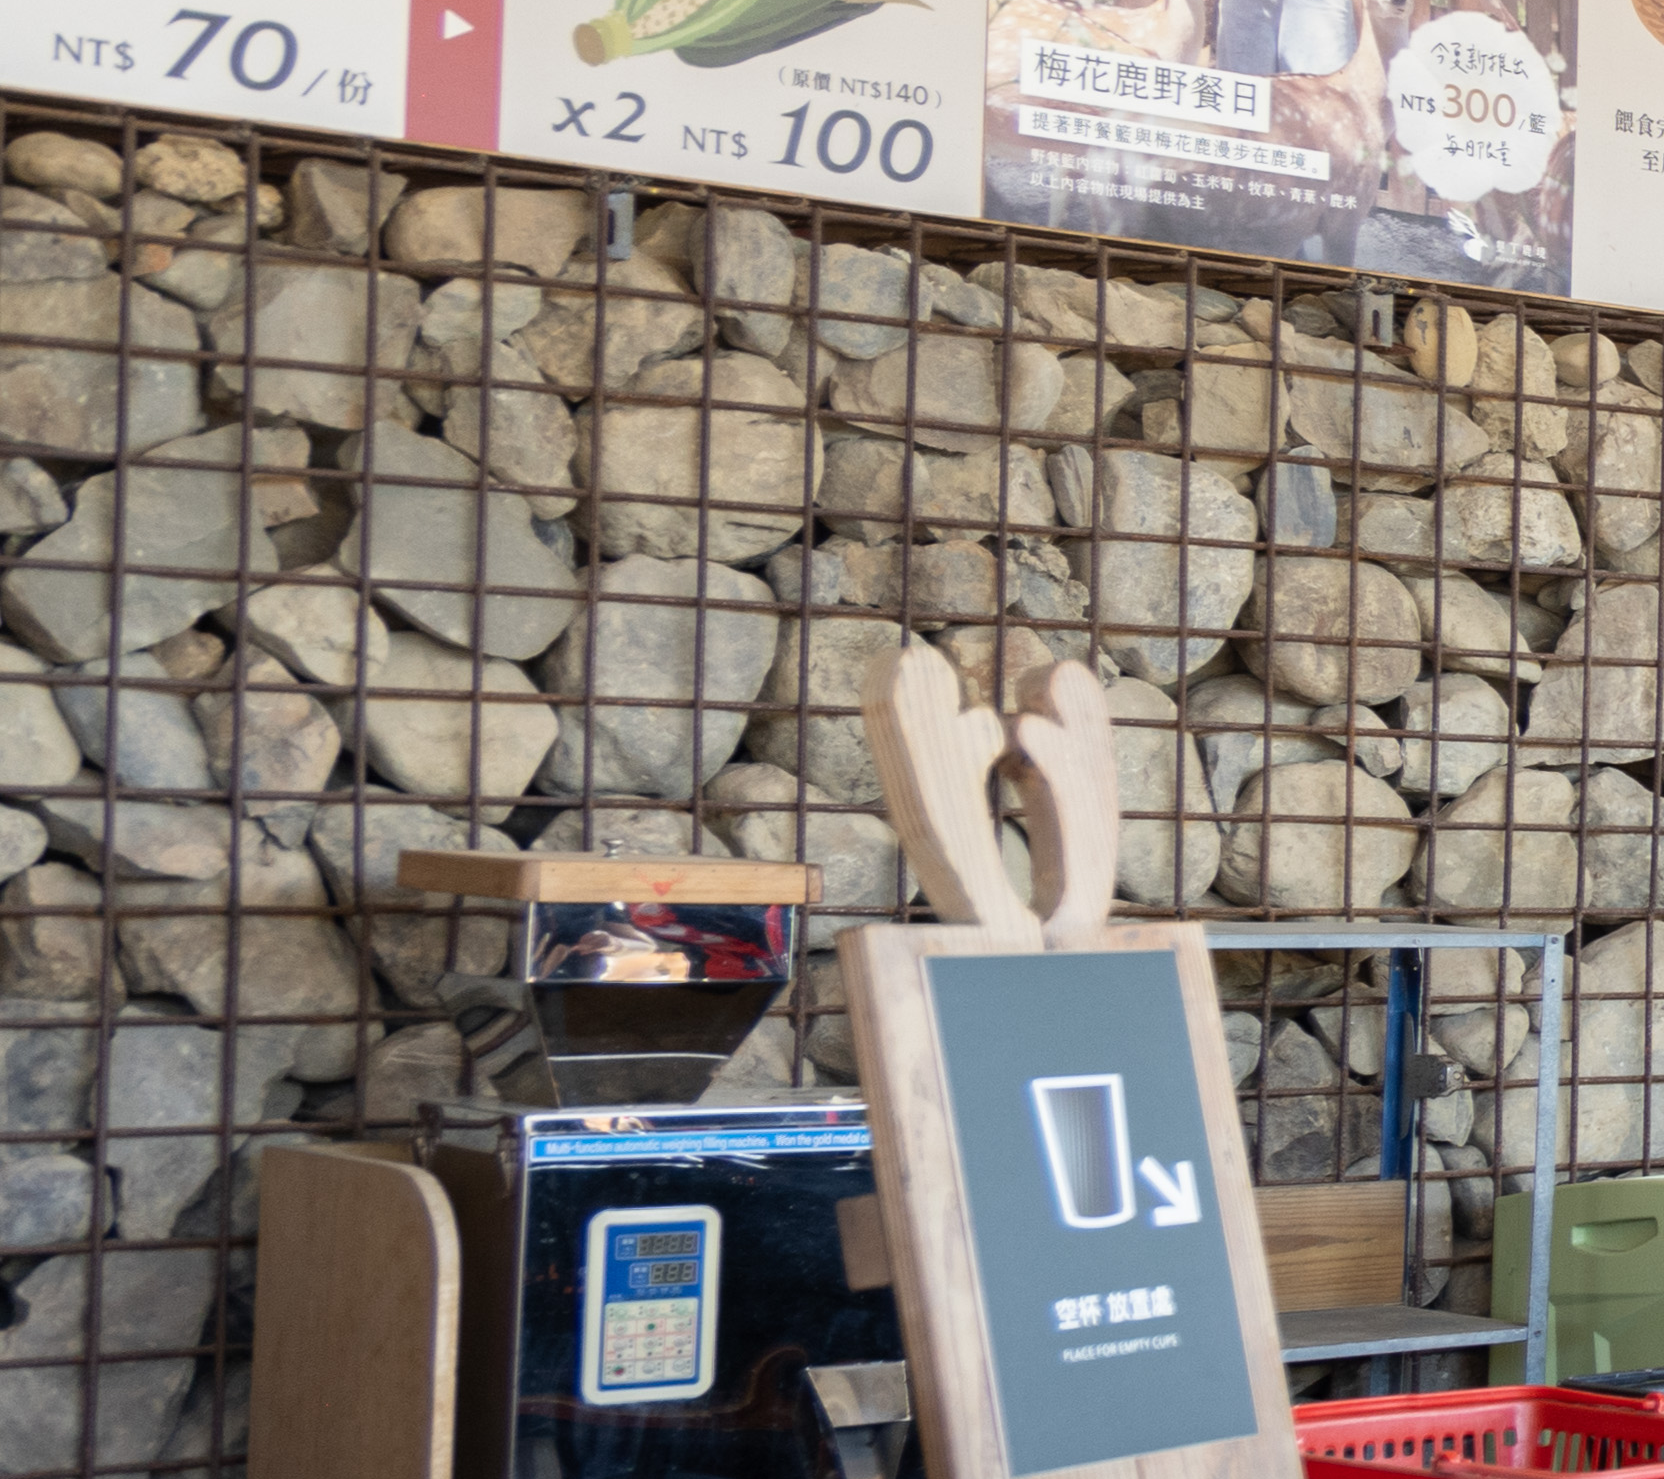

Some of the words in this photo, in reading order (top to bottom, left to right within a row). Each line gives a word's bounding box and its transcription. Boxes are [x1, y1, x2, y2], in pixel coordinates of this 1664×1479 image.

[51, 32, 136, 73] NT$
[1033, 45, 1258, 118] 梅花鹿野餐日
[1400, 93, 1436, 115] NT$
[680, 124, 750, 161] NT$
[768, 98, 935, 185] 100
[1442, 132, 1513, 168] 每日限量
[776, 1132, 796, 1147] Won
[796, 1131, 812, 1146] the
[812, 1129, 833, 1149] gold
[833, 1127, 860, 1145] medal
[1055, 1294, 1102, 1331] 空杯
[1062, 1345, 1096, 1363] PLACE
[1096, 1342, 1118, 1359] FOR
[1118, 1337, 1151, 1356] EMPTY
[1151, 1332, 1180, 1351] CUPS
